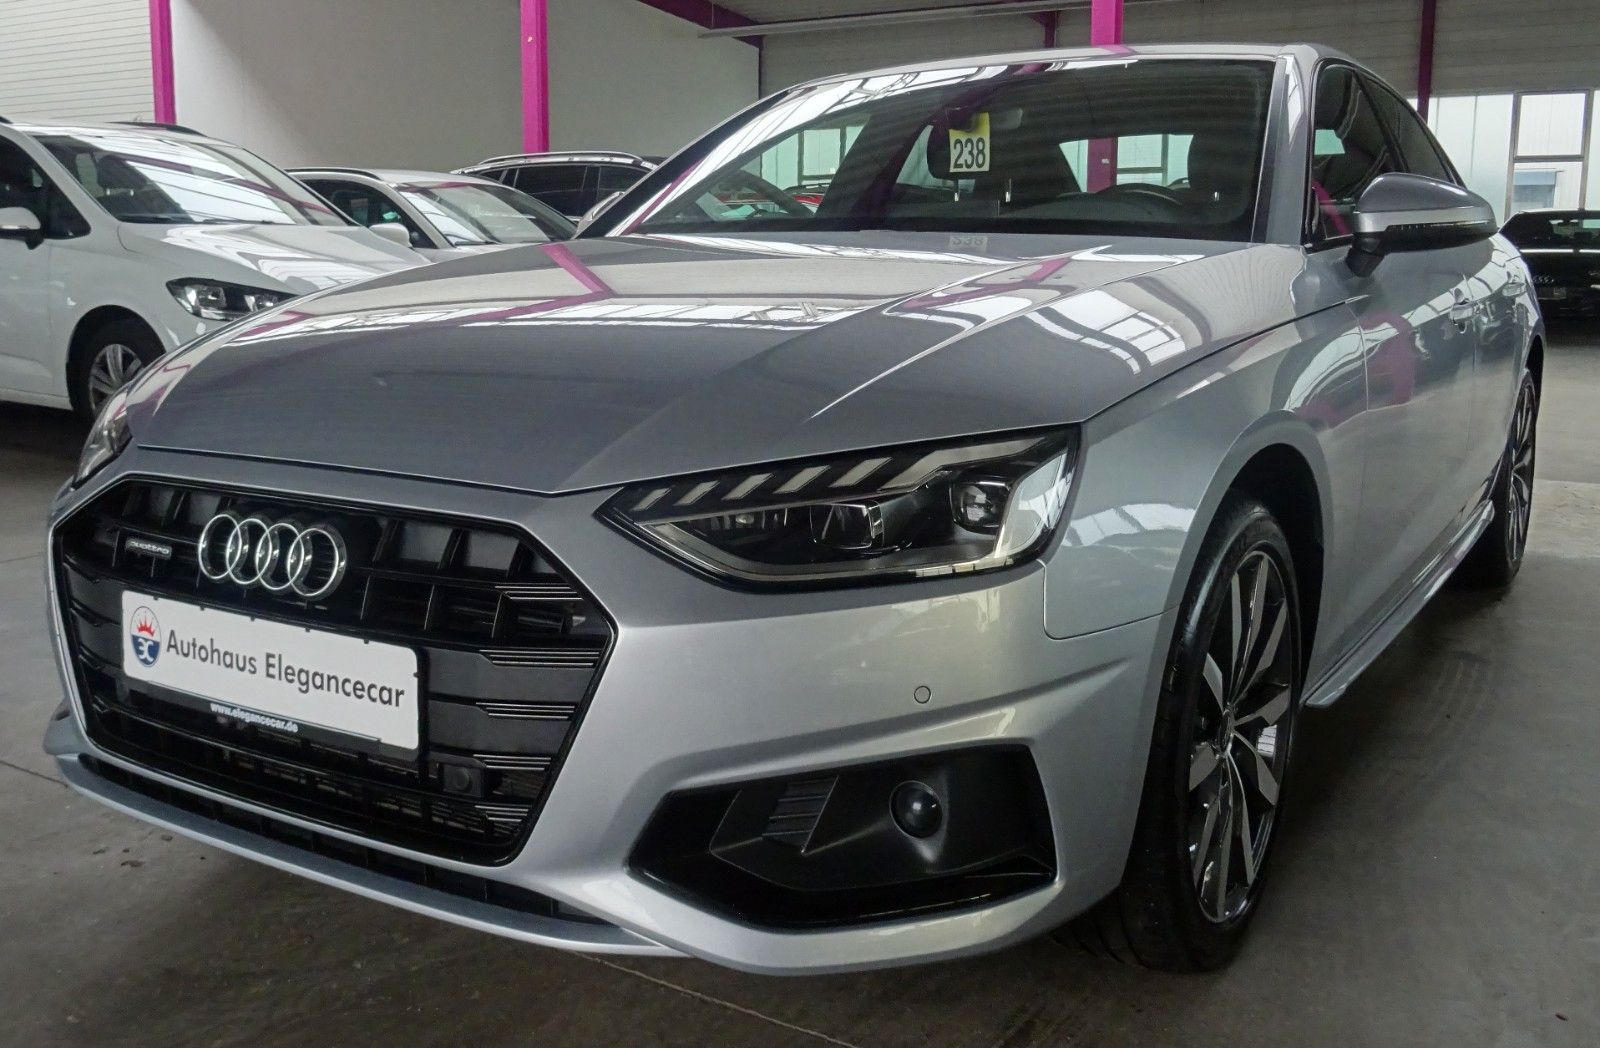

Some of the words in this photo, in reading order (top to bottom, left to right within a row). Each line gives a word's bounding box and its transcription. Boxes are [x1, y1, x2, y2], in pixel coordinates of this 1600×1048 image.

[953, 137, 986, 169] 238
[166, 629, 257, 675] Autohaus
[265, 652, 405, 707] Elegancecar
[209, 702, 299, 733] www.elegancecar.de
